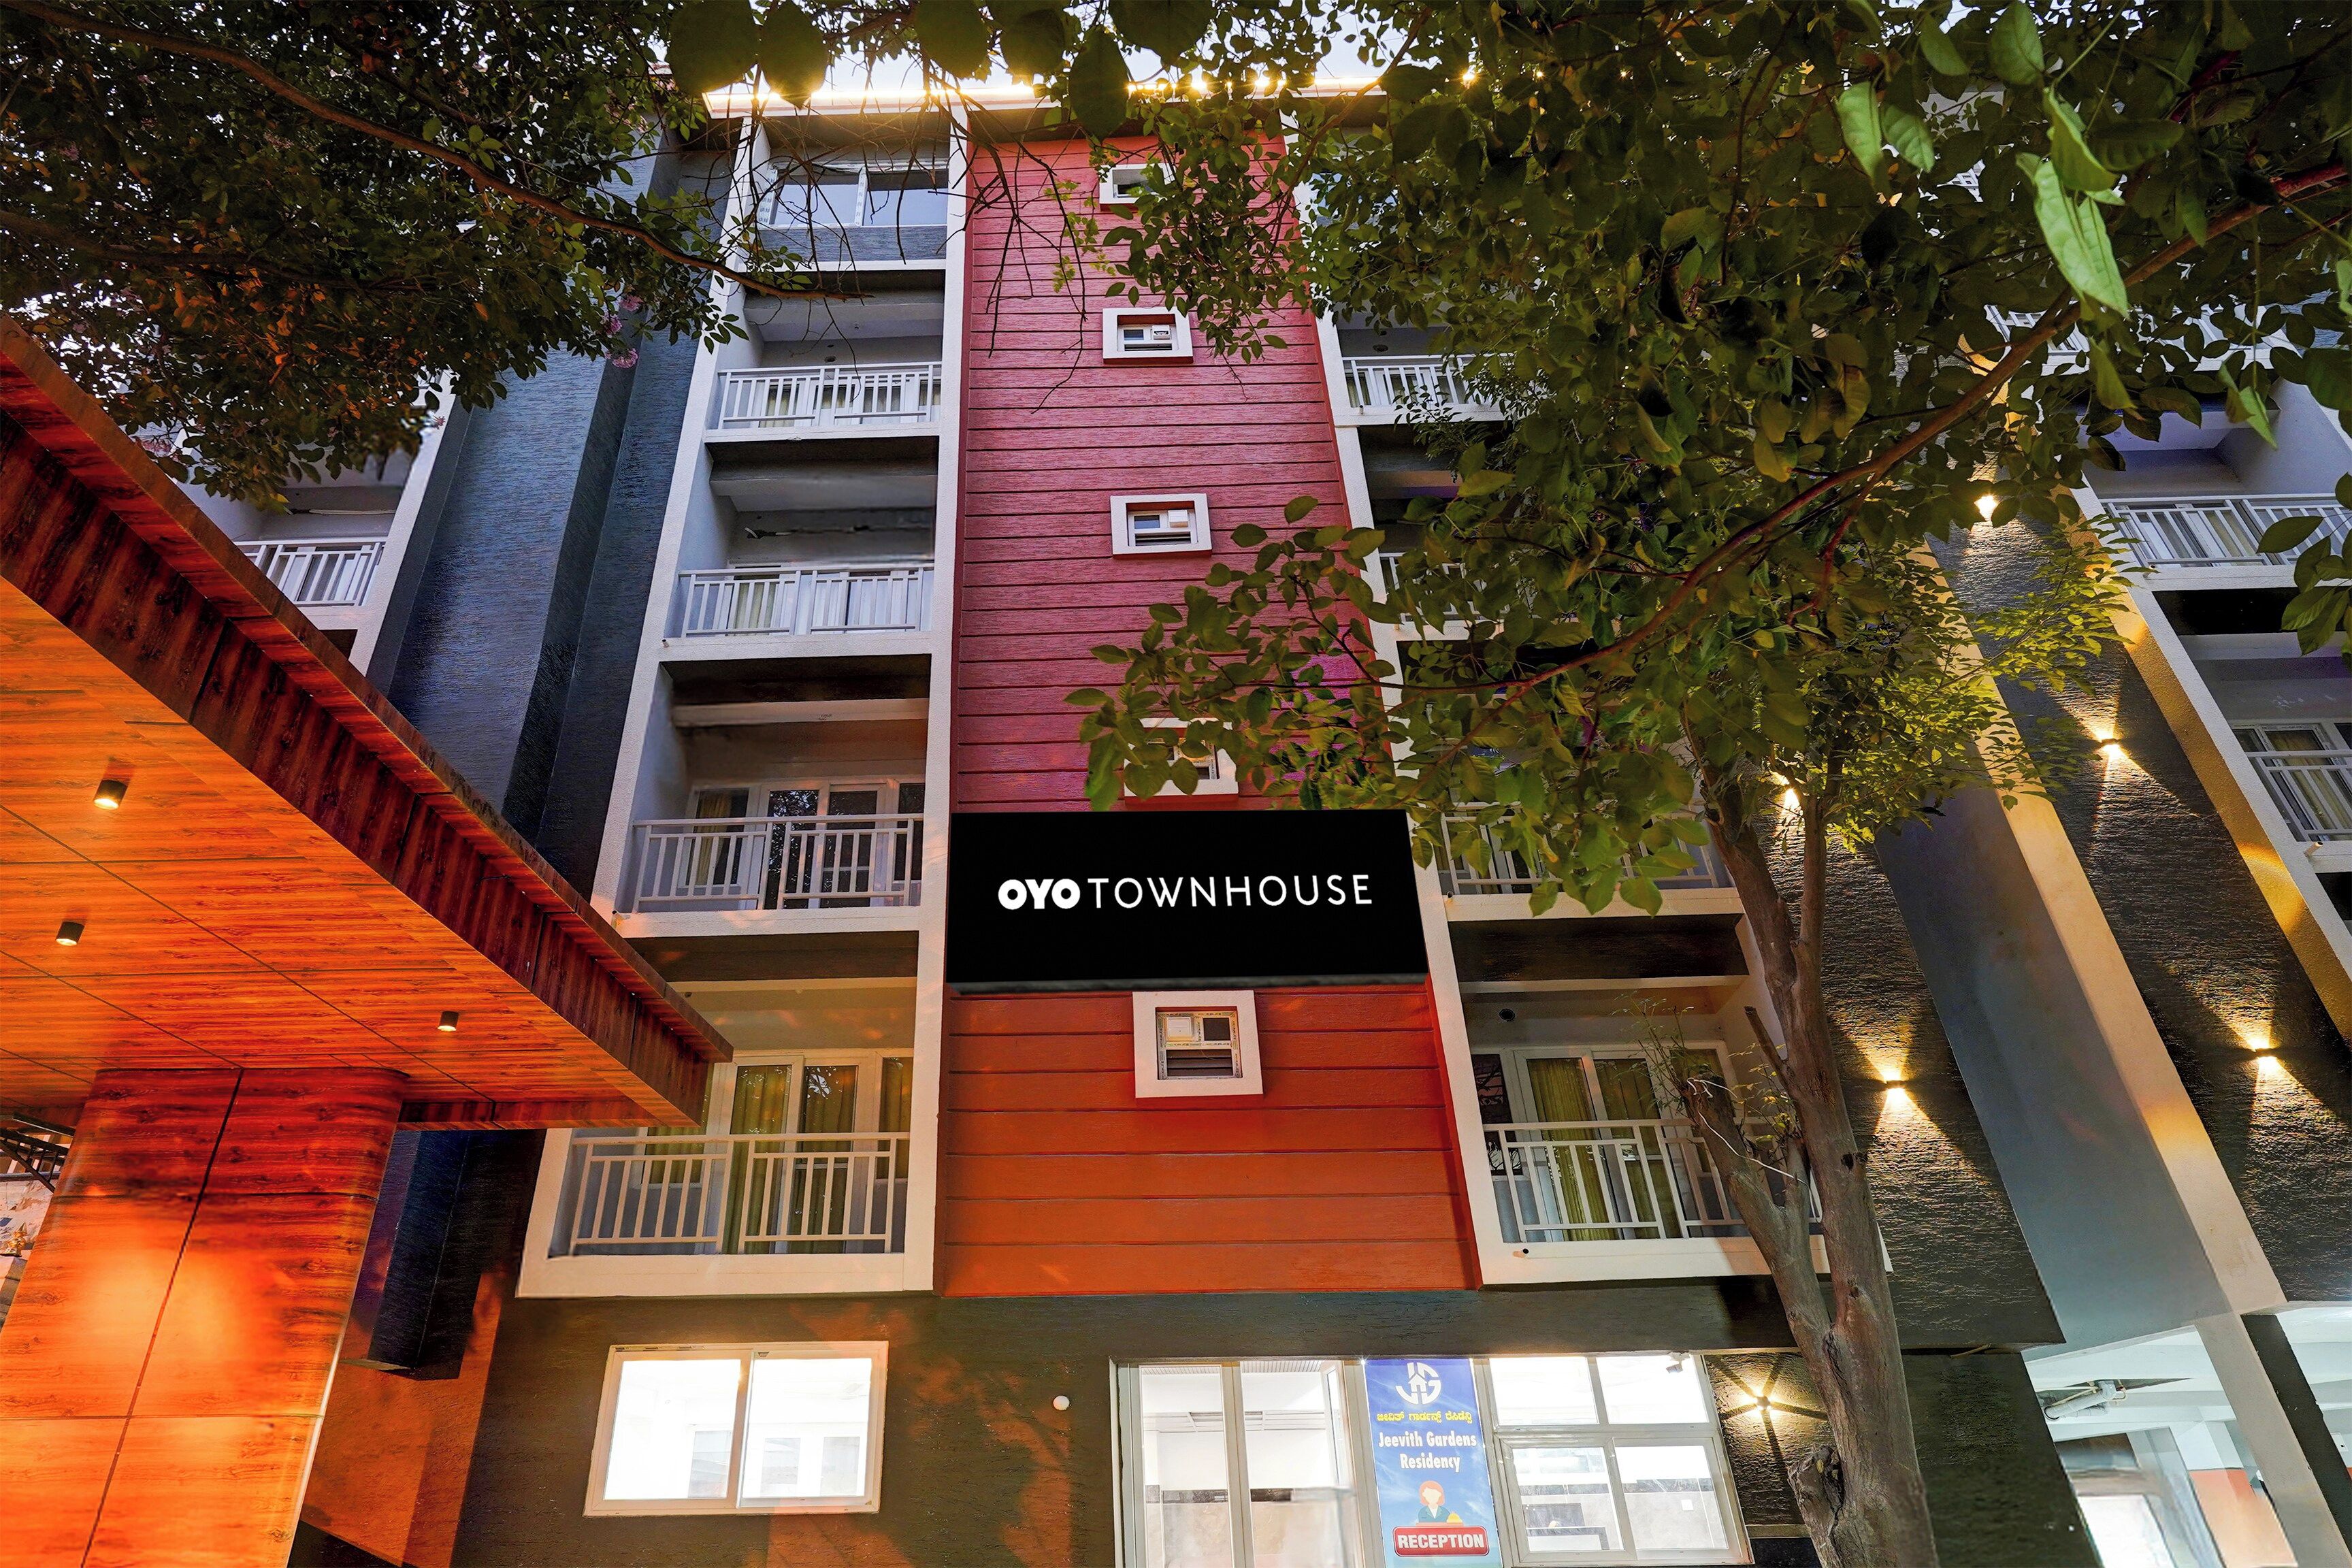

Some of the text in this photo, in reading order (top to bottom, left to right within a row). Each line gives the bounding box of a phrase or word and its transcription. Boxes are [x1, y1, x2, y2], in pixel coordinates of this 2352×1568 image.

[998, 875, 1373, 910] OYO TOWNHOUSE
[1378, 1431, 1477, 1448] Jeevith Gardens
[1399, 1452, 1460, 1473] Residency
[1397, 1533, 1485, 1549] RECEPTION
